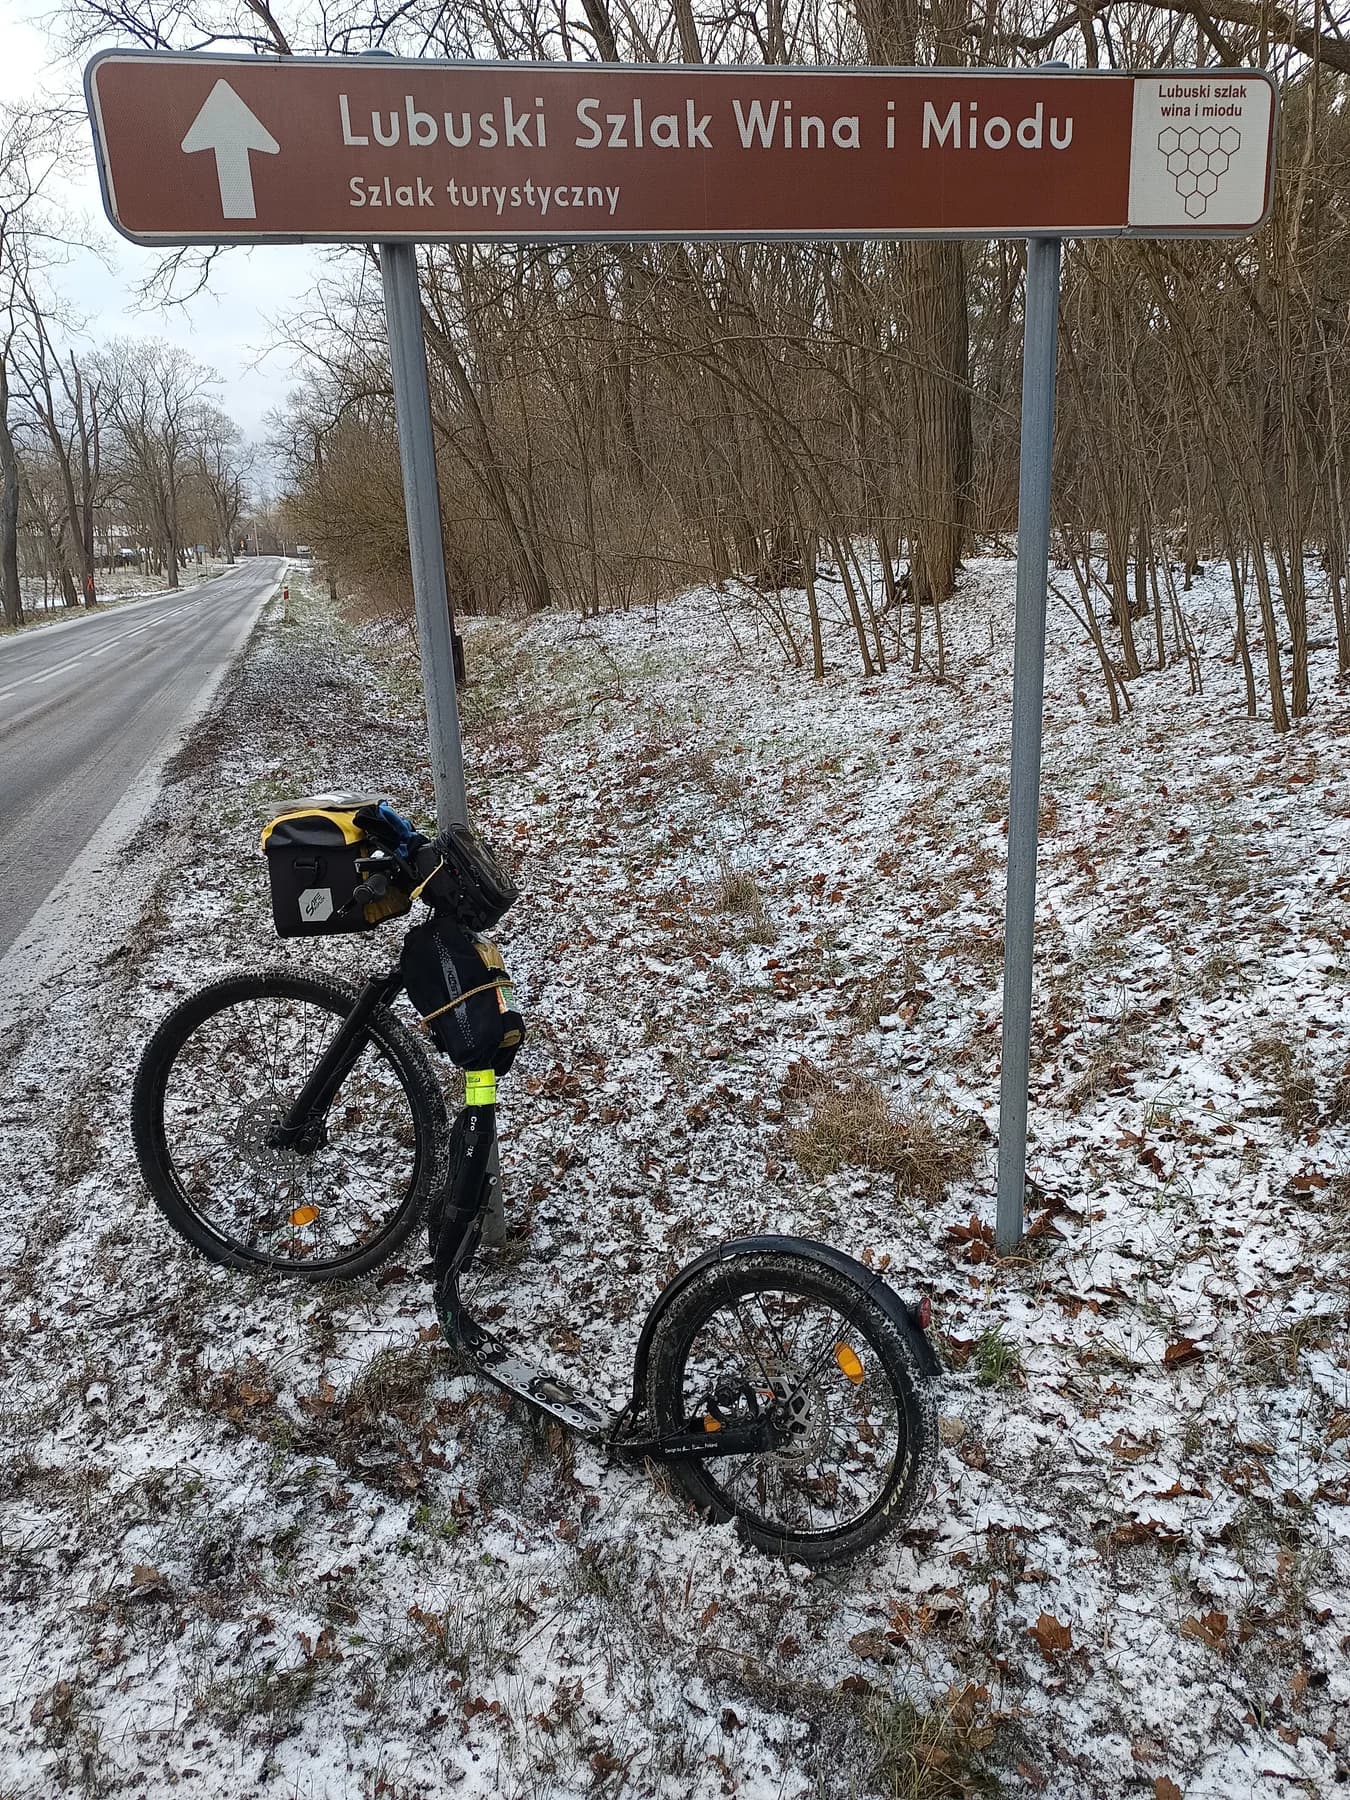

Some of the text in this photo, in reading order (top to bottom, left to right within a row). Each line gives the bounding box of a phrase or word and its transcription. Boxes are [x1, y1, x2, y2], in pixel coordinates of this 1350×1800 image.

[1158, 84, 1247, 98] Lubuski szlak
[339, 94, 1073, 150] Lubuski Szlak Wina i Miodu
[1160, 103, 1242, 117] wina i miodu
[349, 176, 621, 215] Szlak turystyczny
